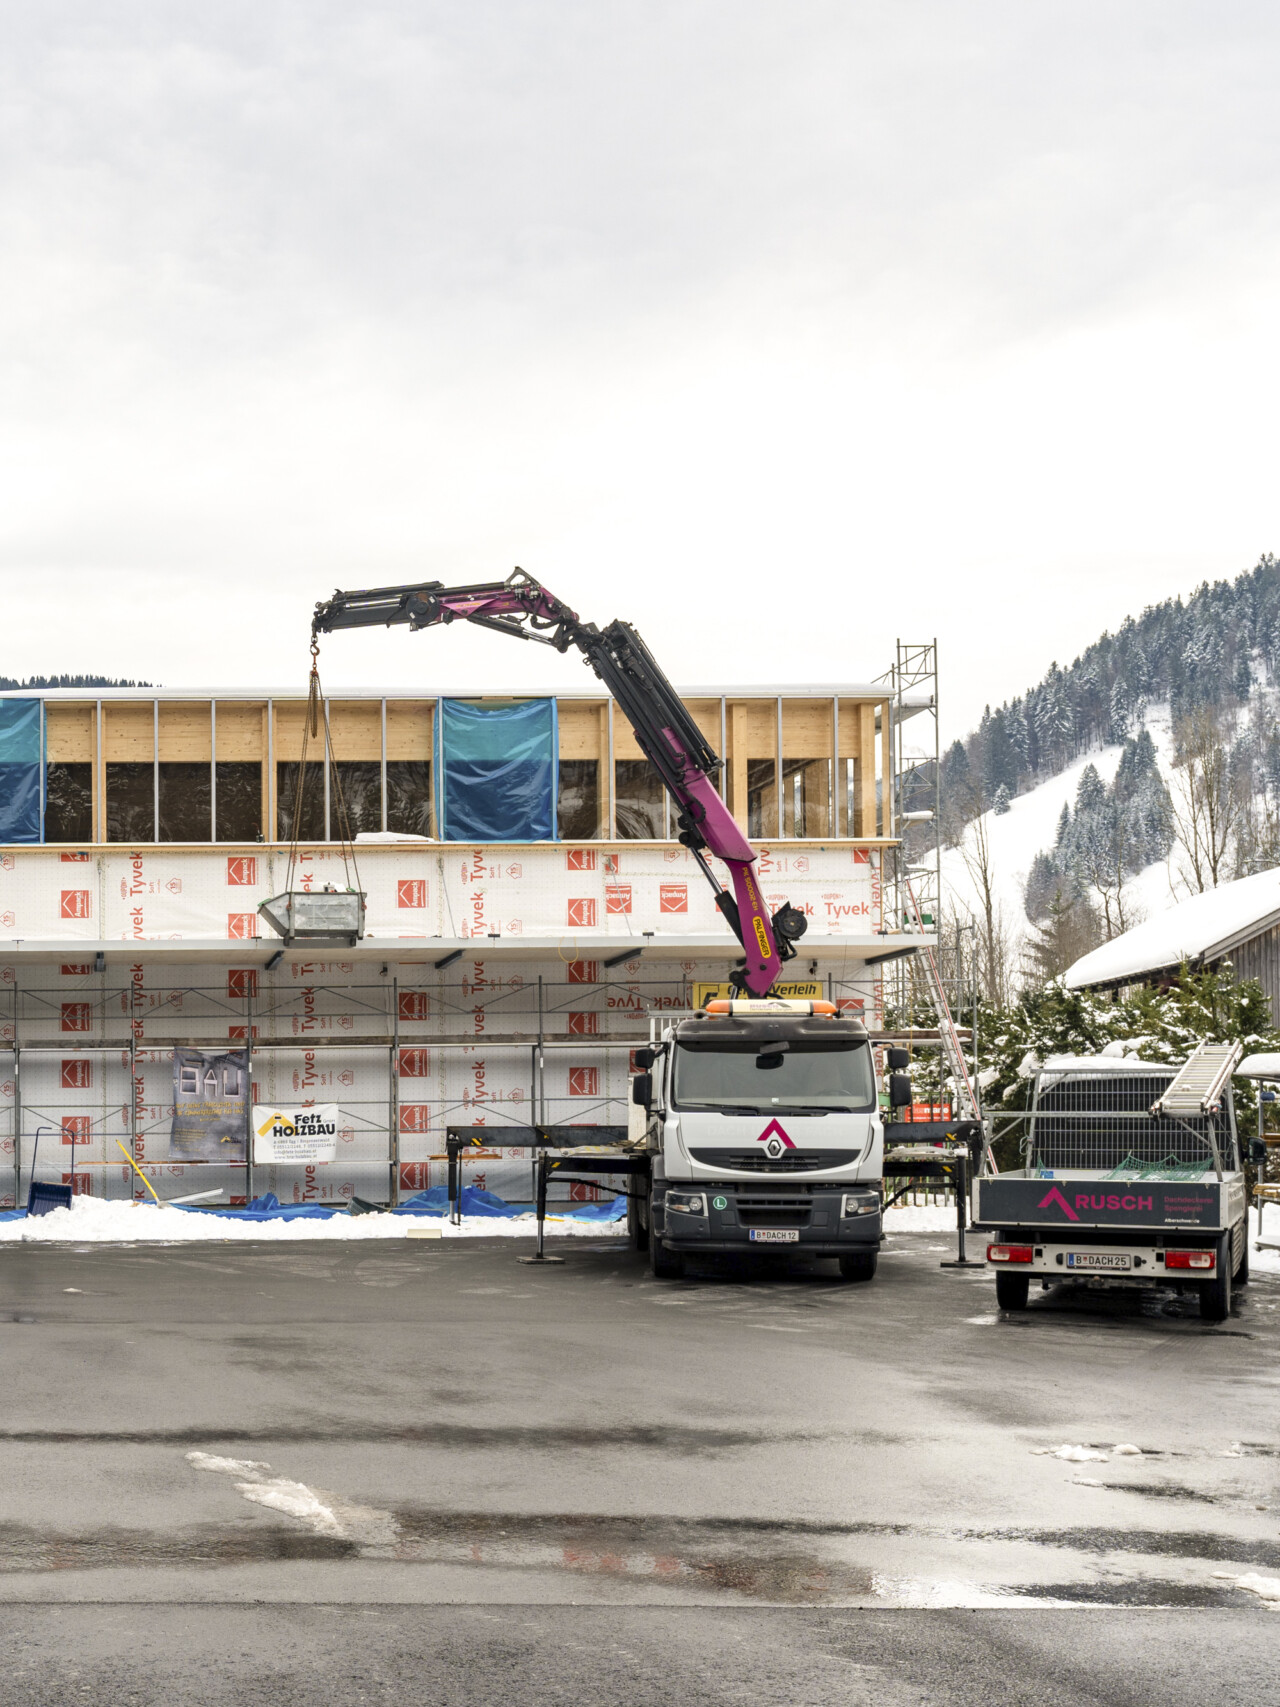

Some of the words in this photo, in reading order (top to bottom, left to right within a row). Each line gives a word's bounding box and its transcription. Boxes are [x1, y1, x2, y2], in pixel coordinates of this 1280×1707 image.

[130, 851, 146, 896] Tyvek
[241, 858, 250, 884] Ampack
[758, 850, 774, 876] Tyv
[411, 881, 420, 907] Ampack
[662, 891, 686, 900] Ampack
[470, 892, 487, 937] Tyvek
[581, 900, 590, 925] Ampack
[824, 902, 869, 918] Tyvek
[754, 918, 769, 956] PALFINGER
[301, 987, 318, 1032] Tyvek
[75, 1061, 84, 1087] Ampack
[302, 1048, 318, 1089] Tyve
[413, 1050, 422, 1076] Ampack
[583, 1069, 592, 1094] Ampack
[273, 1124, 335, 1137] HOLZBAU
[294, 1114, 321, 1124] Fetz
[303, 1165, 319, 1201] Tyve
[413, 1164, 422, 1189] Ampack
[717, 1198, 723, 1207] L
[1075, 1195, 1152, 1210] RUSCH
[1089, 1257, 1113, 1265] DACH
